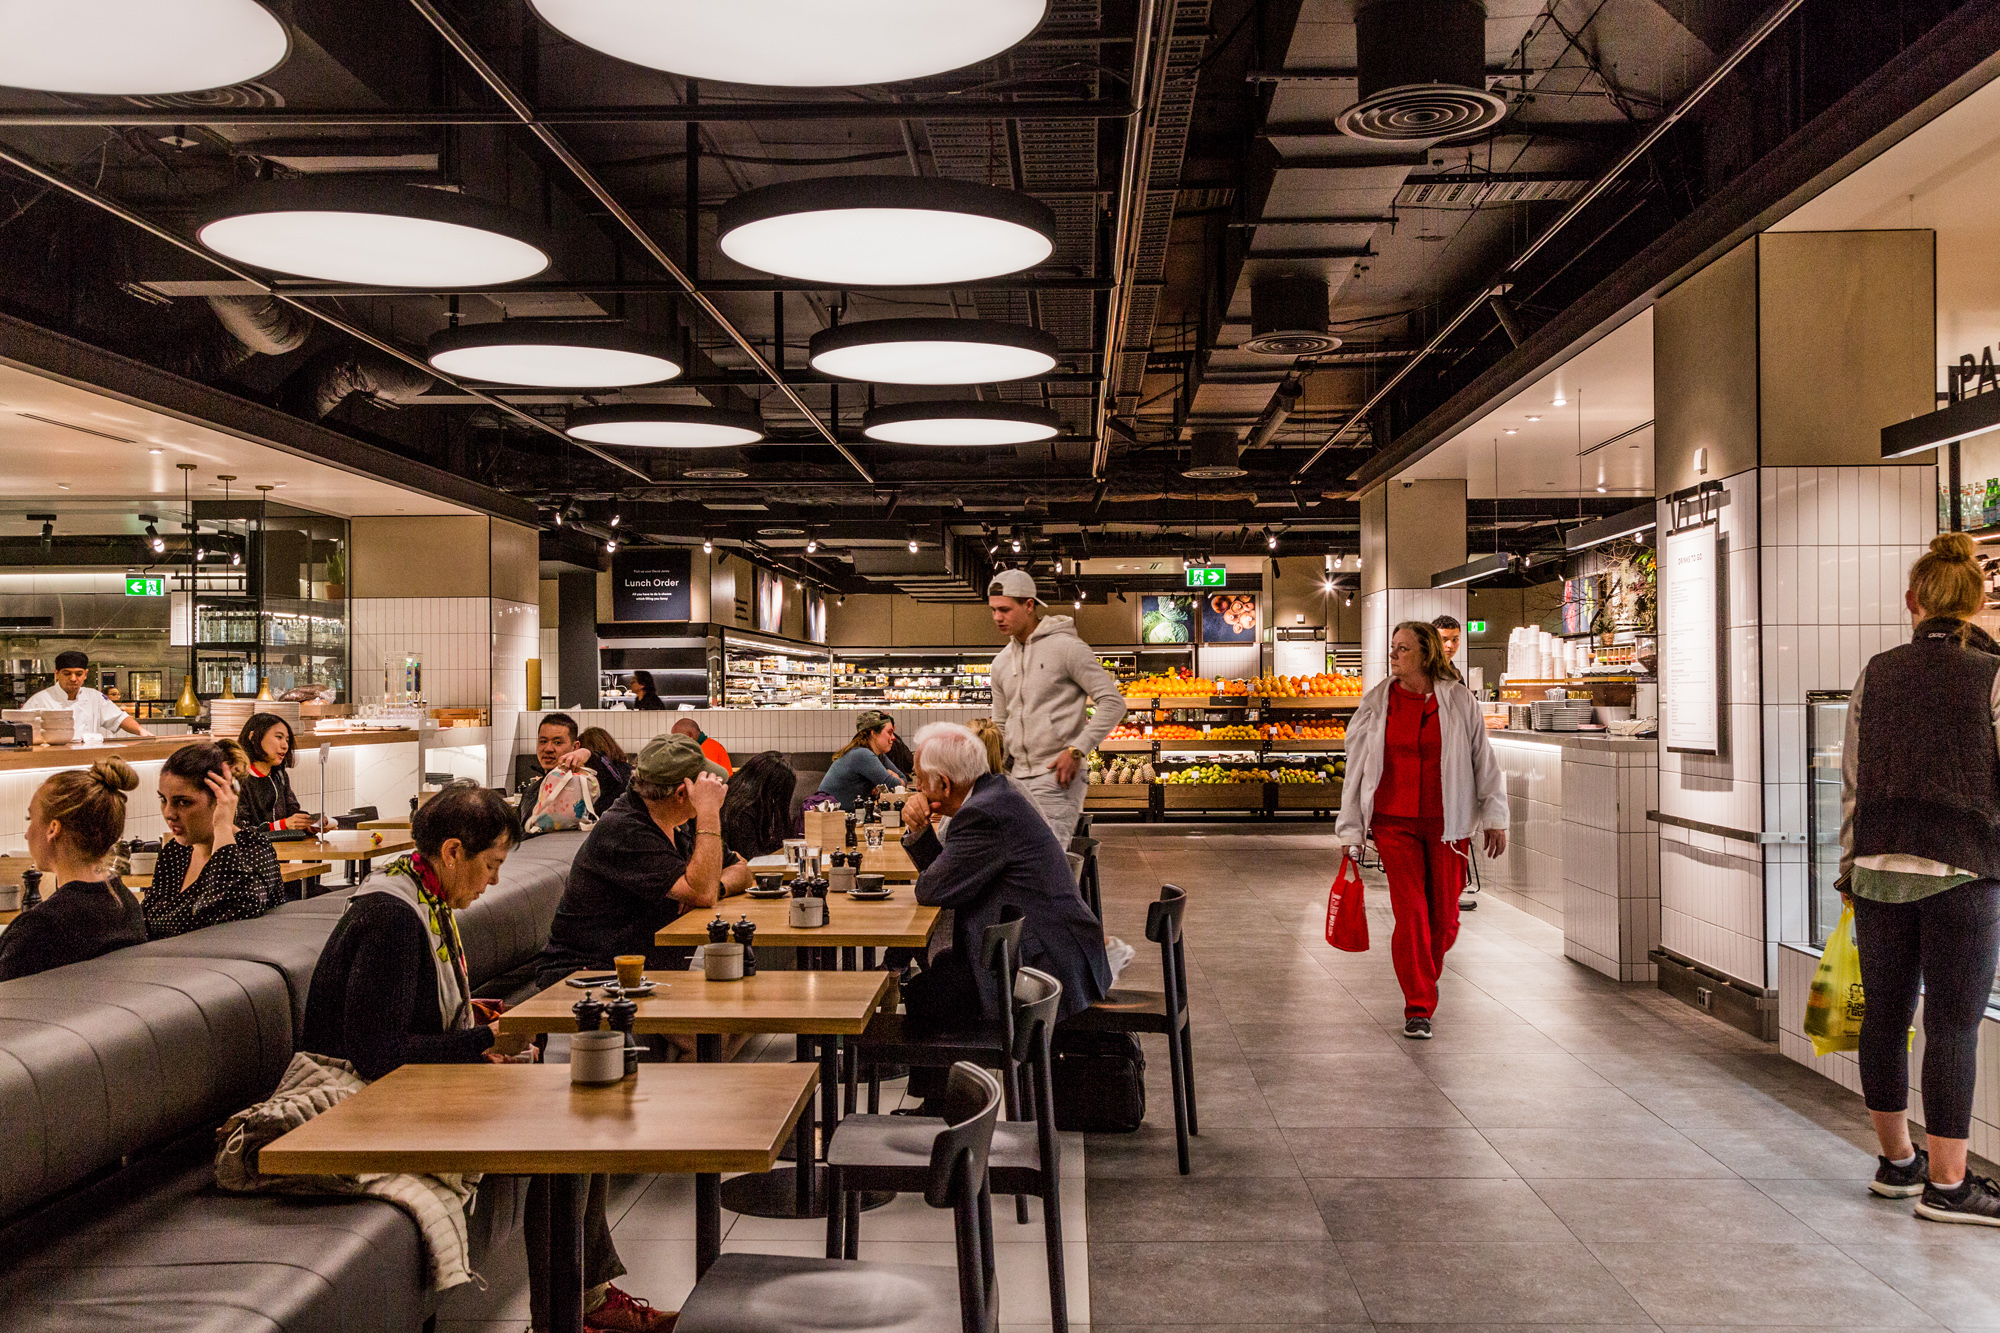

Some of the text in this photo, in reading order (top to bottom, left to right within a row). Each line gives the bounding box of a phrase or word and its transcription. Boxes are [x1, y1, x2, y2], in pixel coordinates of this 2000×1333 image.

[1959, 342, 2000, 401] PA
[624, 578, 680, 587] Lunch Order
